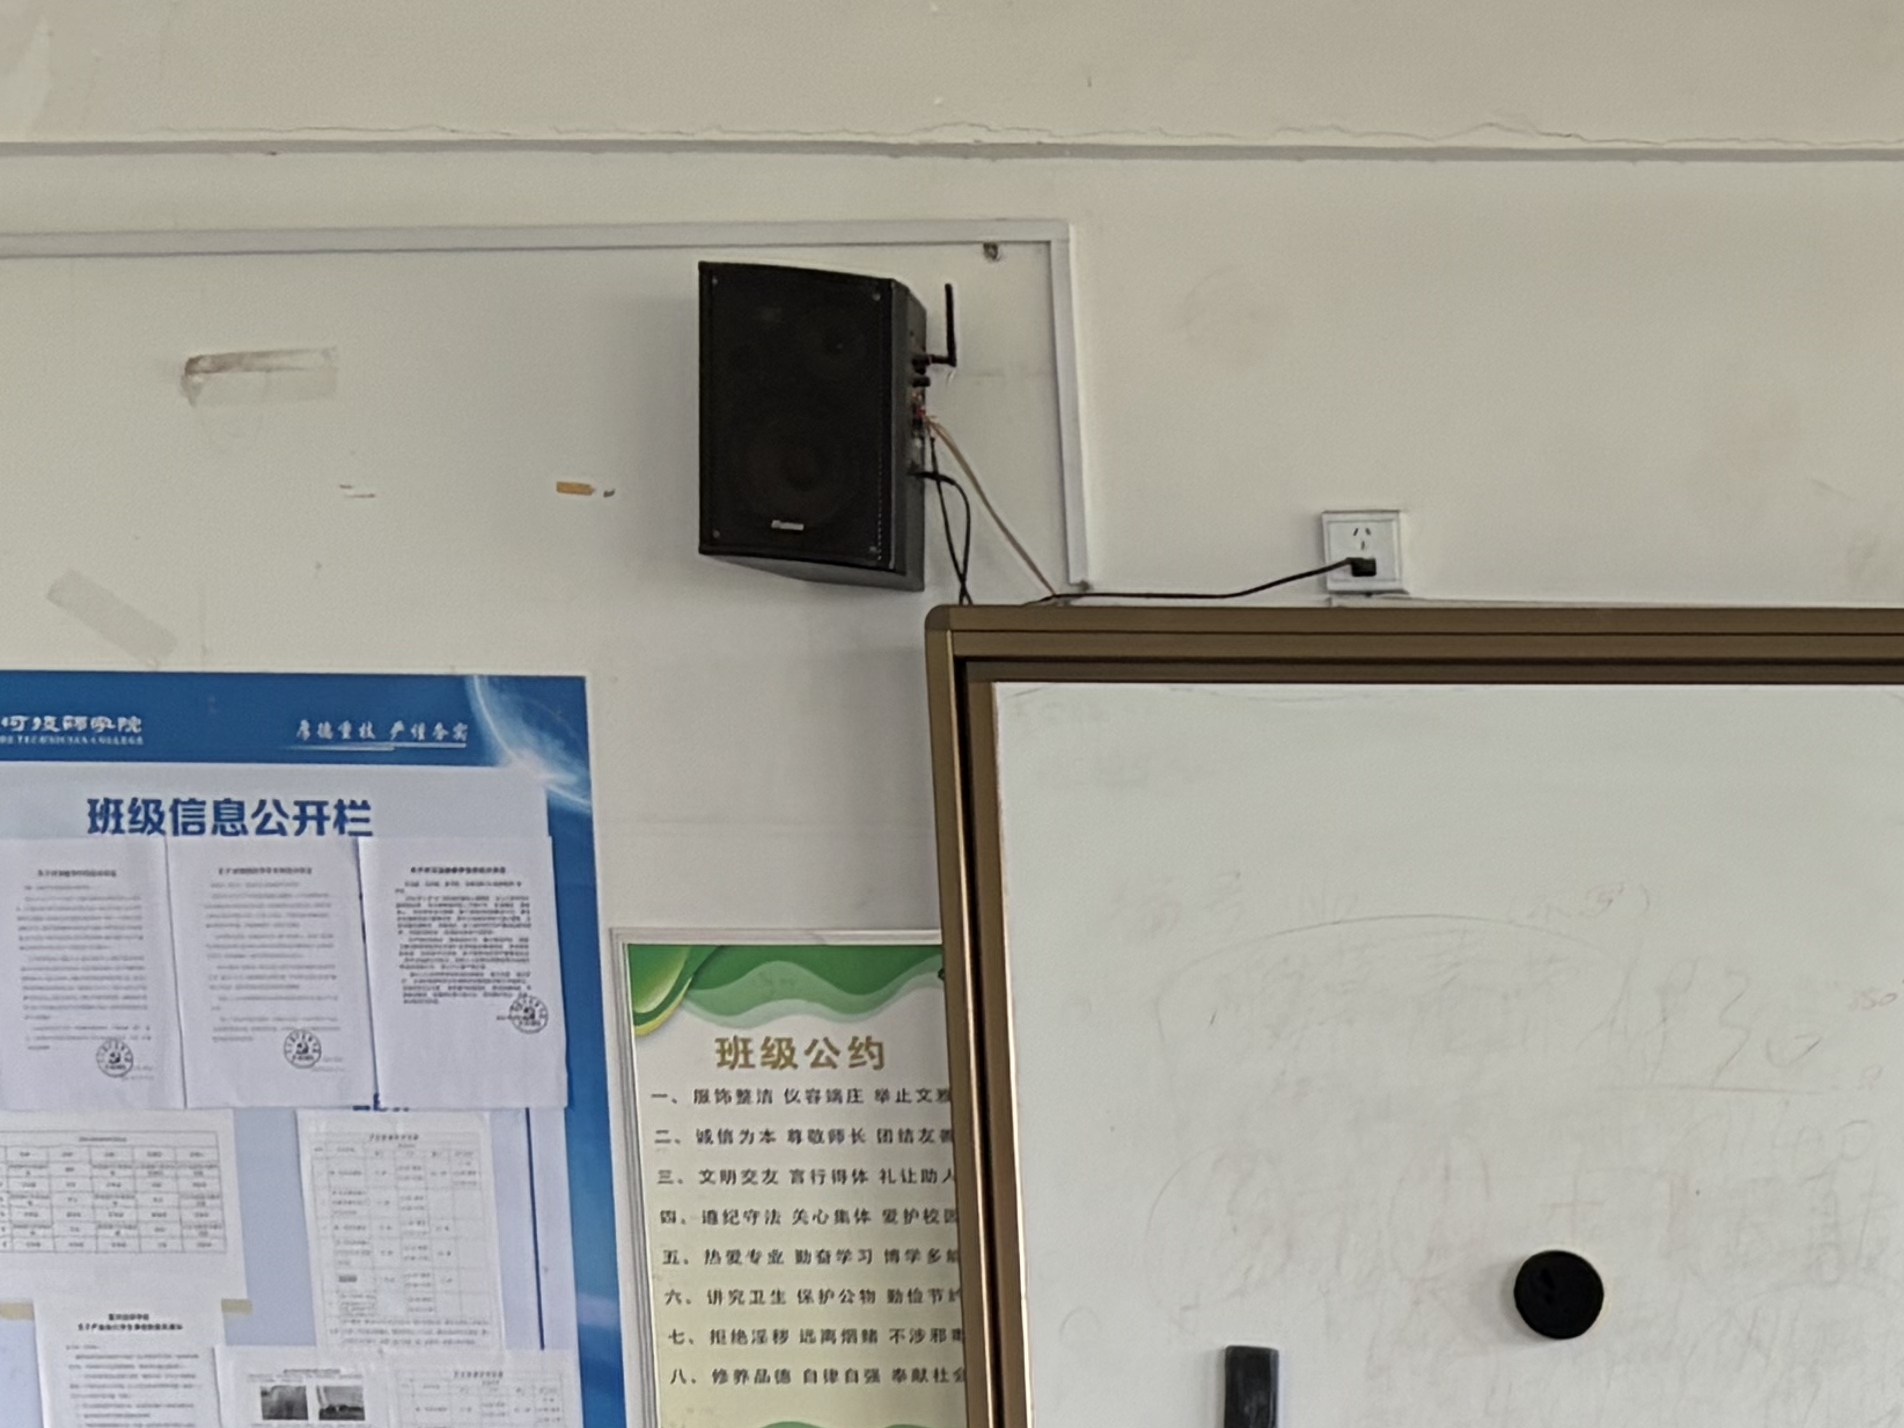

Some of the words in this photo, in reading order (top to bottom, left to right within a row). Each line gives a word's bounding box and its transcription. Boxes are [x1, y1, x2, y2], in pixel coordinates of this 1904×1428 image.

[86, 796, 374, 837] 班级信息公开栏
[714, 1035, 886, 1071] 班级公约
